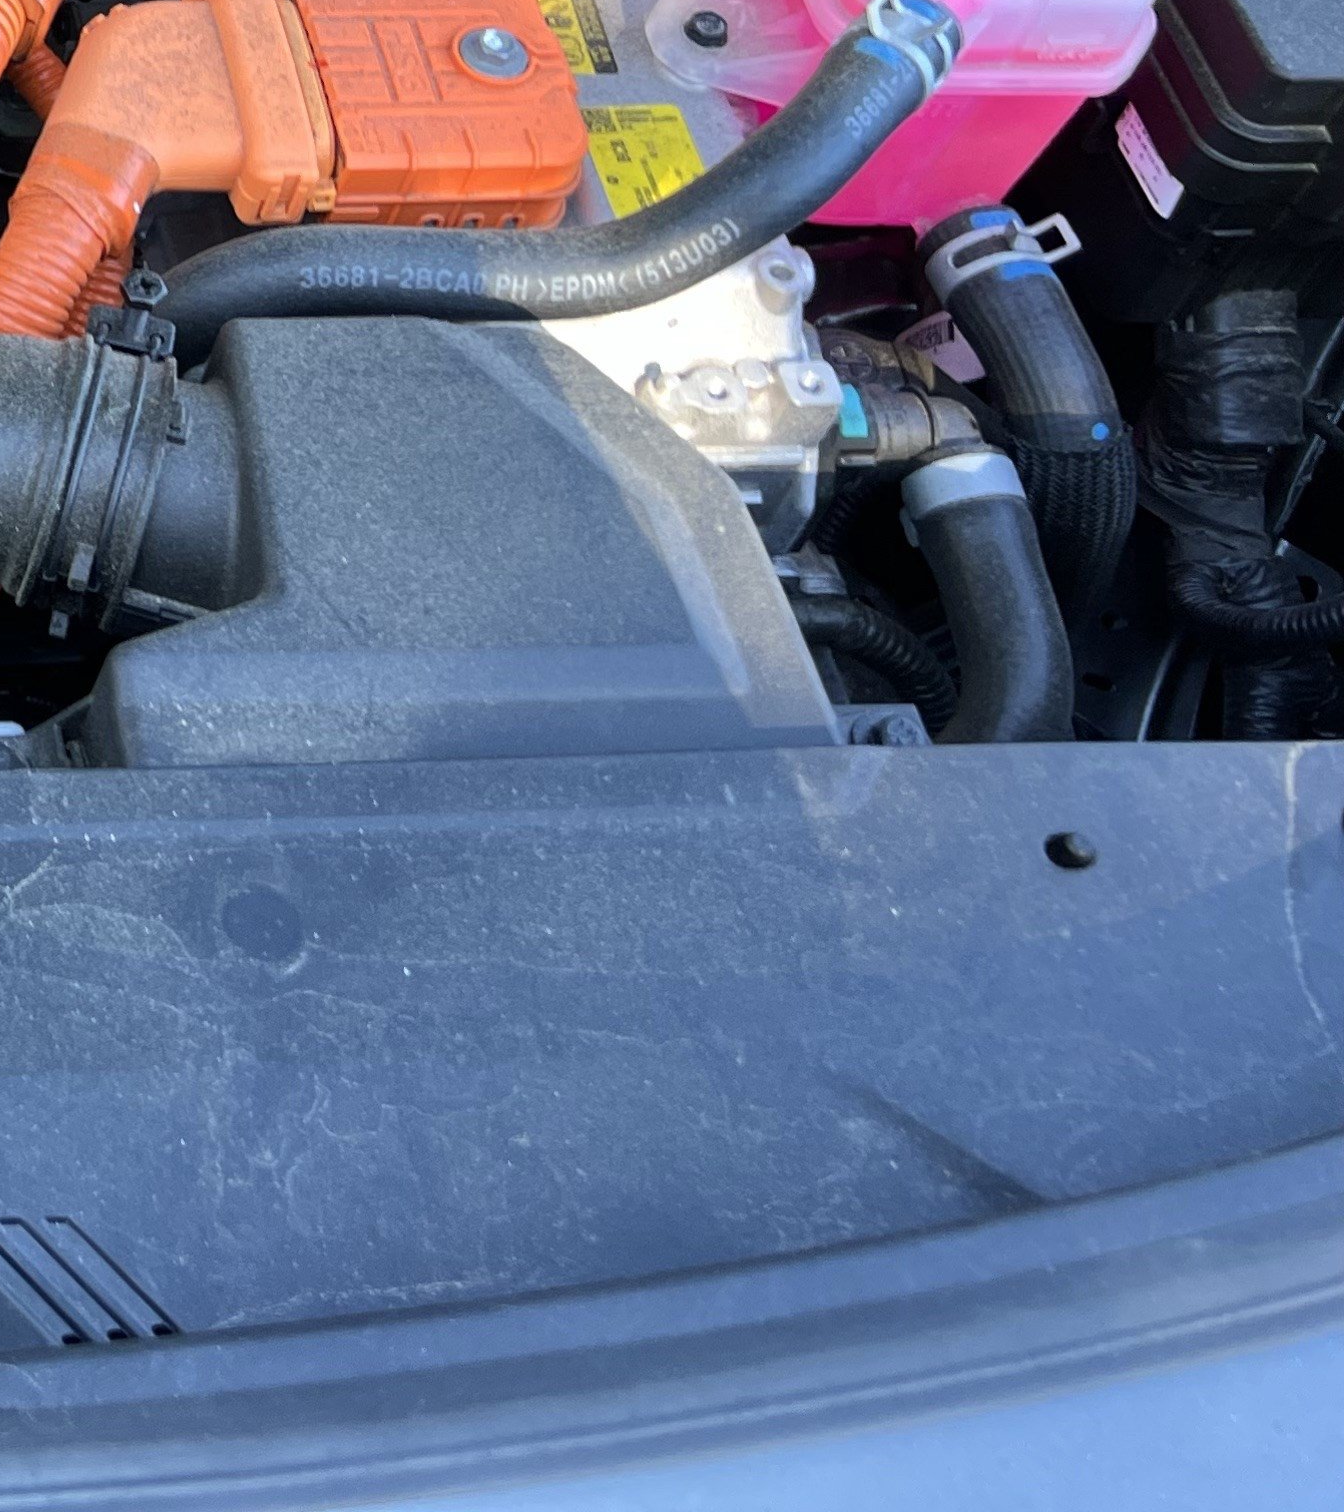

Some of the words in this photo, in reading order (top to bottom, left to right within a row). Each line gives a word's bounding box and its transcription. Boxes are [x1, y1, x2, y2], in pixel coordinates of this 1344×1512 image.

[299, 264, 489, 296] 36681-2BCA0
[495, 276, 528, 302] PH
[634, 216, 741, 292] (513U03)
